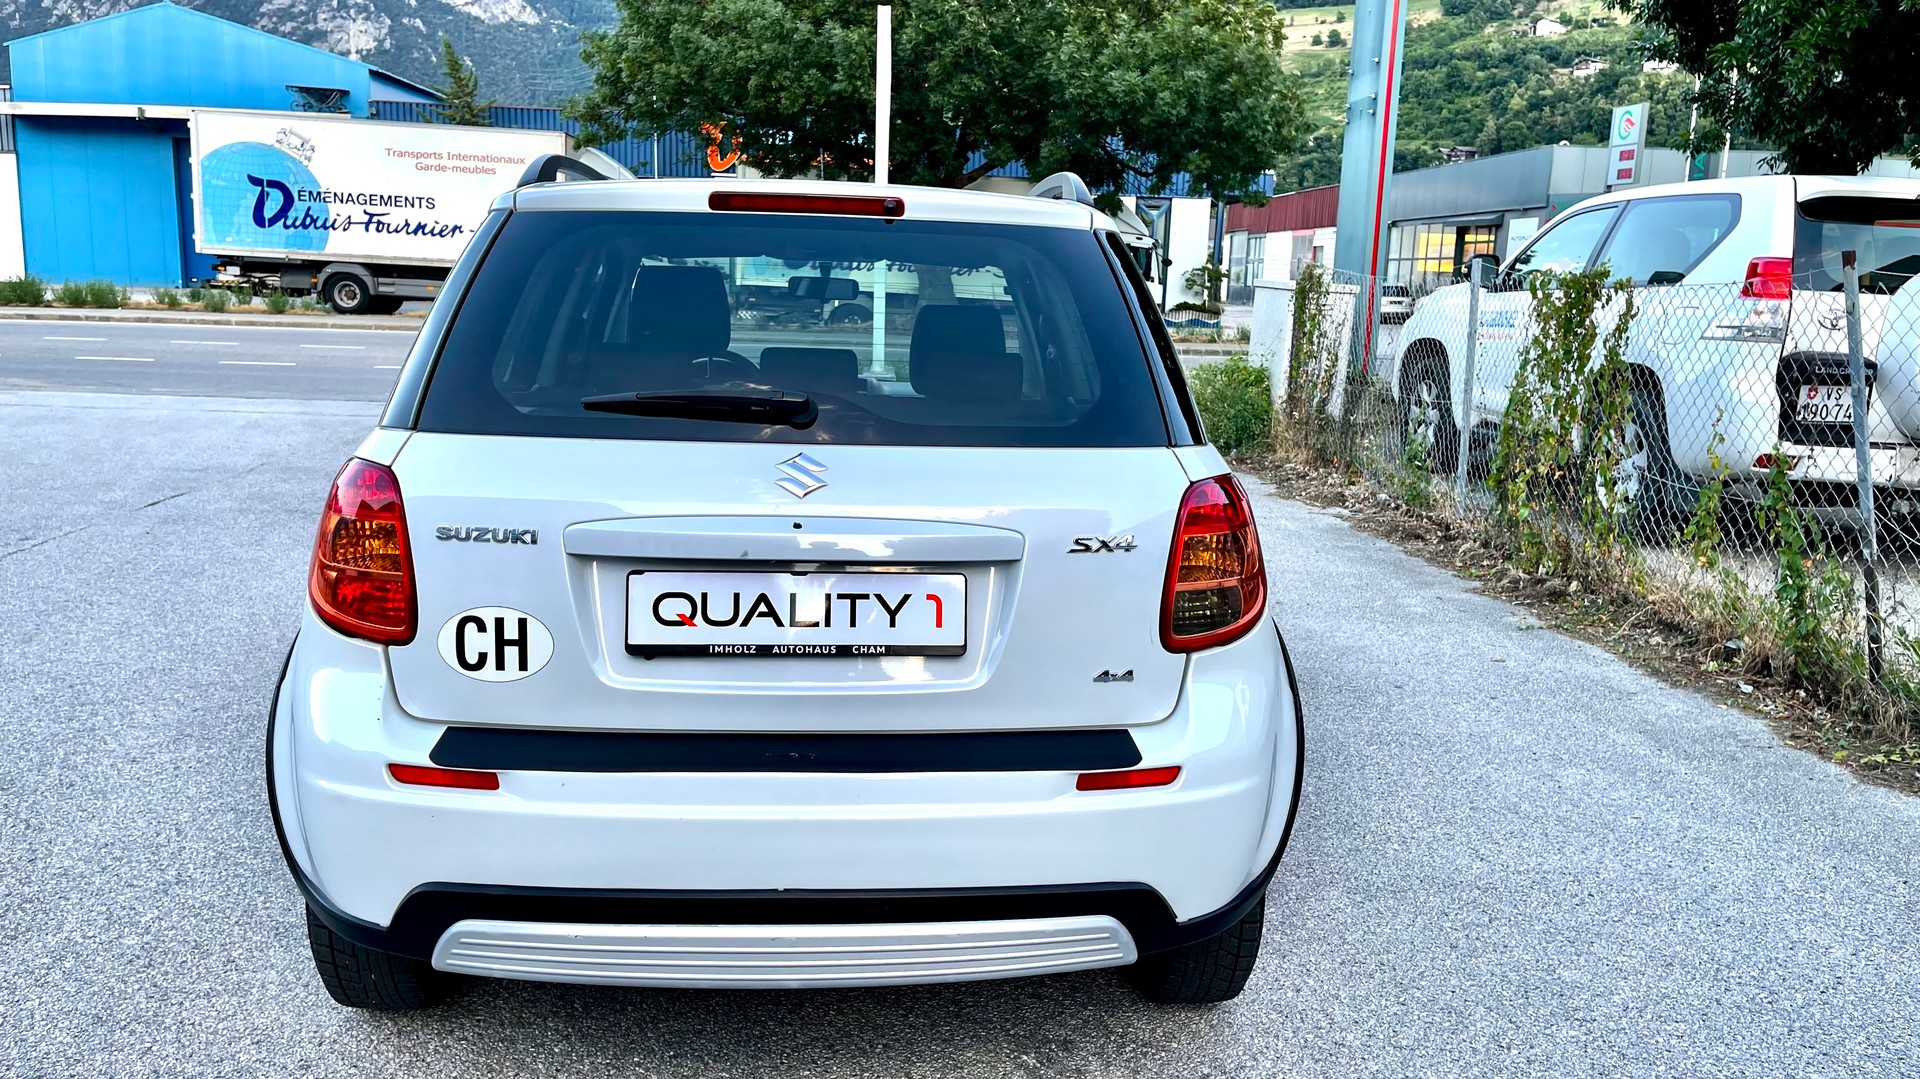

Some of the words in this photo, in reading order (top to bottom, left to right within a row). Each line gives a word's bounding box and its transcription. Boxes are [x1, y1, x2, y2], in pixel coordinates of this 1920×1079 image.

[385, 148, 443, 160] Transports
[447, 153, 525, 165] Internationaux
[415, 162, 497, 175] Garde-meubles
[363, 209, 465, 240] Fournier
[1827, 388, 1842, 400] VS
[435, 524, 540, 545] SUZUKI
[1067, 535, 1138, 554] SX4
[651, 591, 913, 628] QUALITY
[926, 594, 944, 628] 1
[454, 615, 530, 673] CH
[709, 645, 757, 655] IMHOLZ
[772, 645, 838, 655] AUTOHAUS
[852, 645, 886, 655] CHAM
